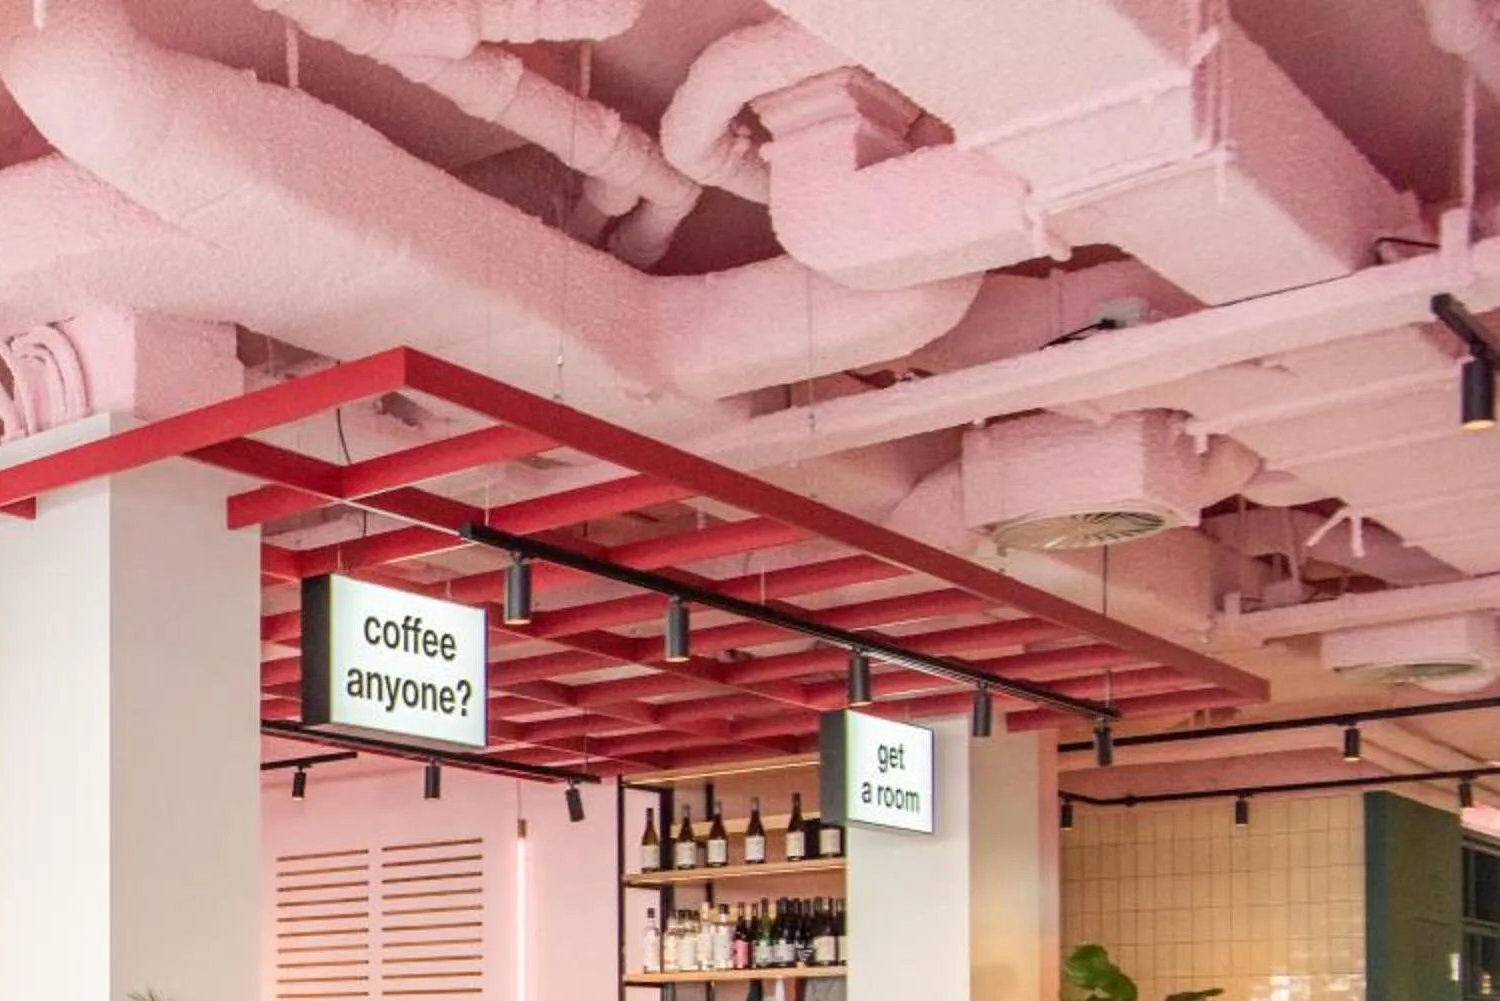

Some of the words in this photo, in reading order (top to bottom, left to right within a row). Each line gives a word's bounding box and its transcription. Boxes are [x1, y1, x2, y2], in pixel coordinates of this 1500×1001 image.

[363, 615, 457, 661] coffee
[346, 667, 472, 717] anyone?
[877, 744, 906, 774] get
[861, 781, 873, 804] a
[877, 785, 921, 814] room
